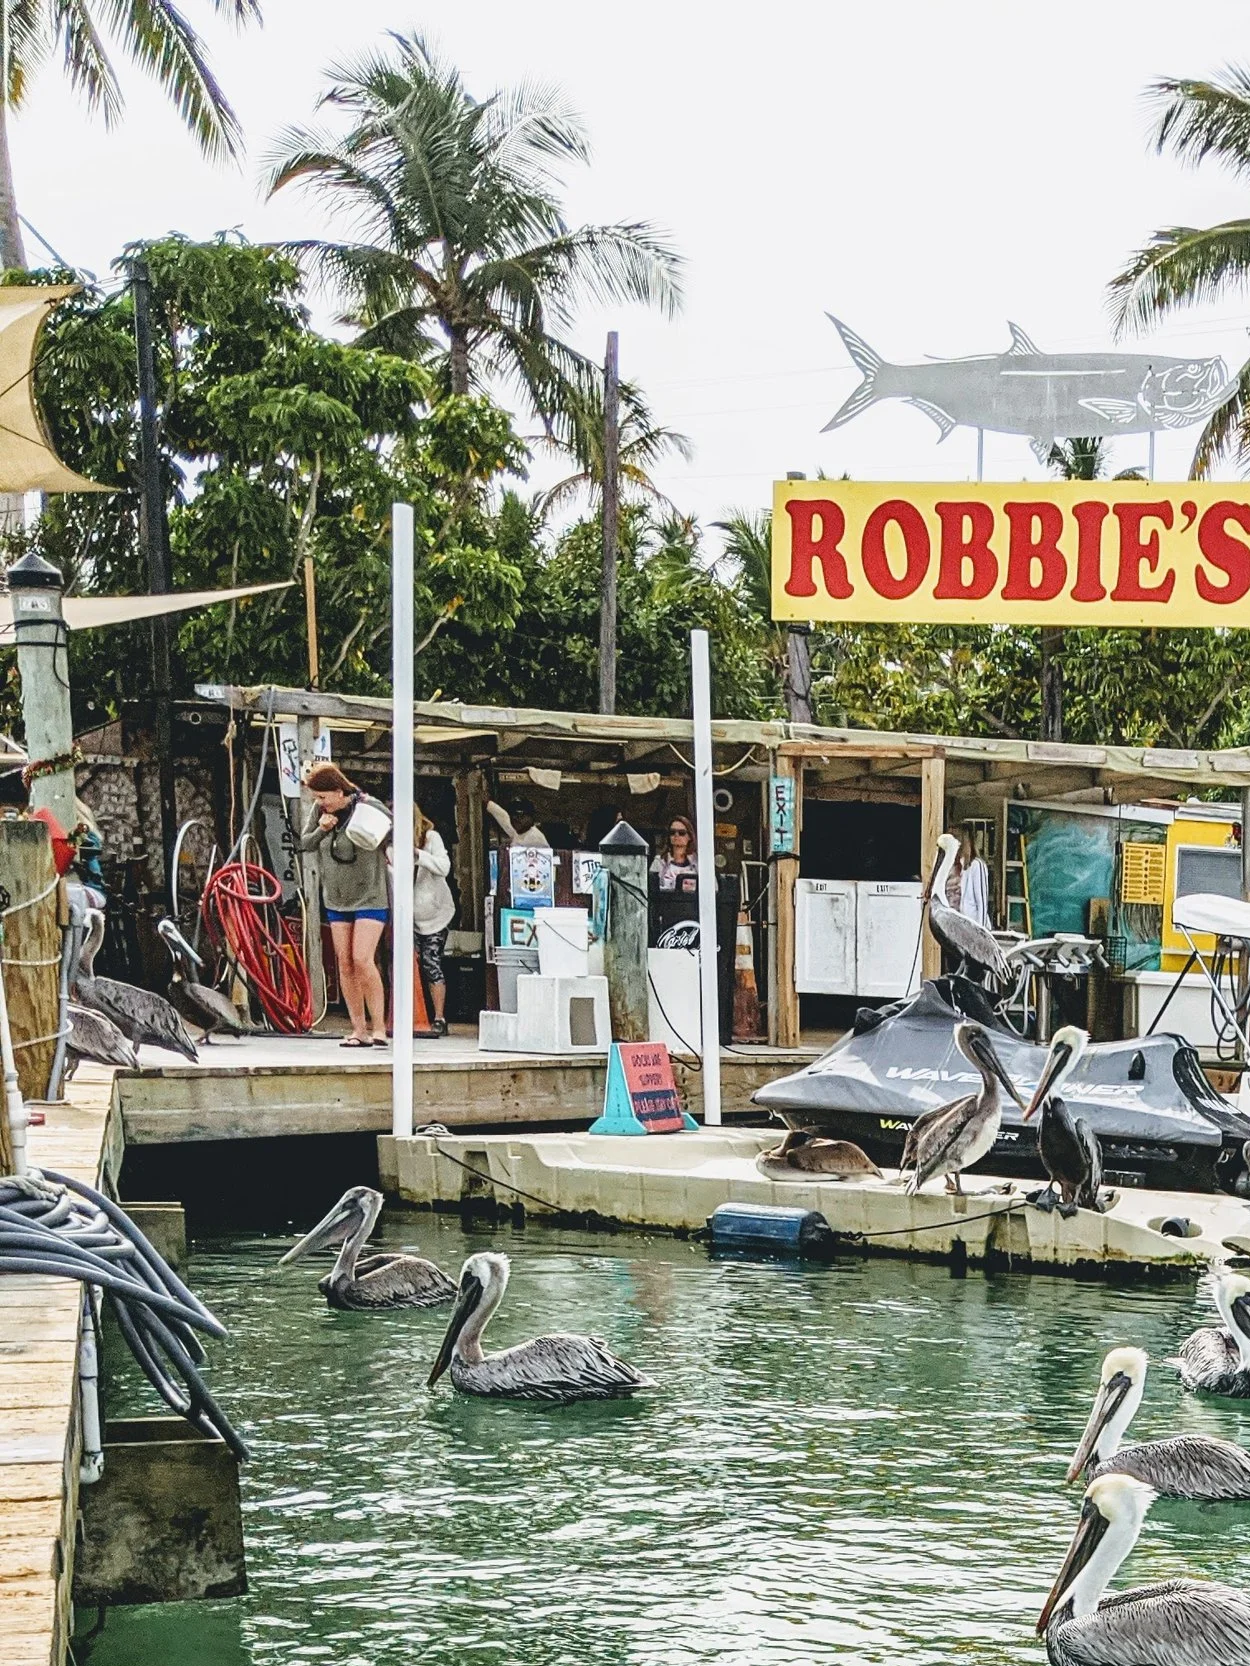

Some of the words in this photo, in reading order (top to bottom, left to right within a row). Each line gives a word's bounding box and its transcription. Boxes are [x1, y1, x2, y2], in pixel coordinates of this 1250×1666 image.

[775, 785, 788, 844] EXIT
[815, 883, 827, 891] EXIT
[876, 884, 889, 893] EXIT
[511, 918, 538, 947] EX
